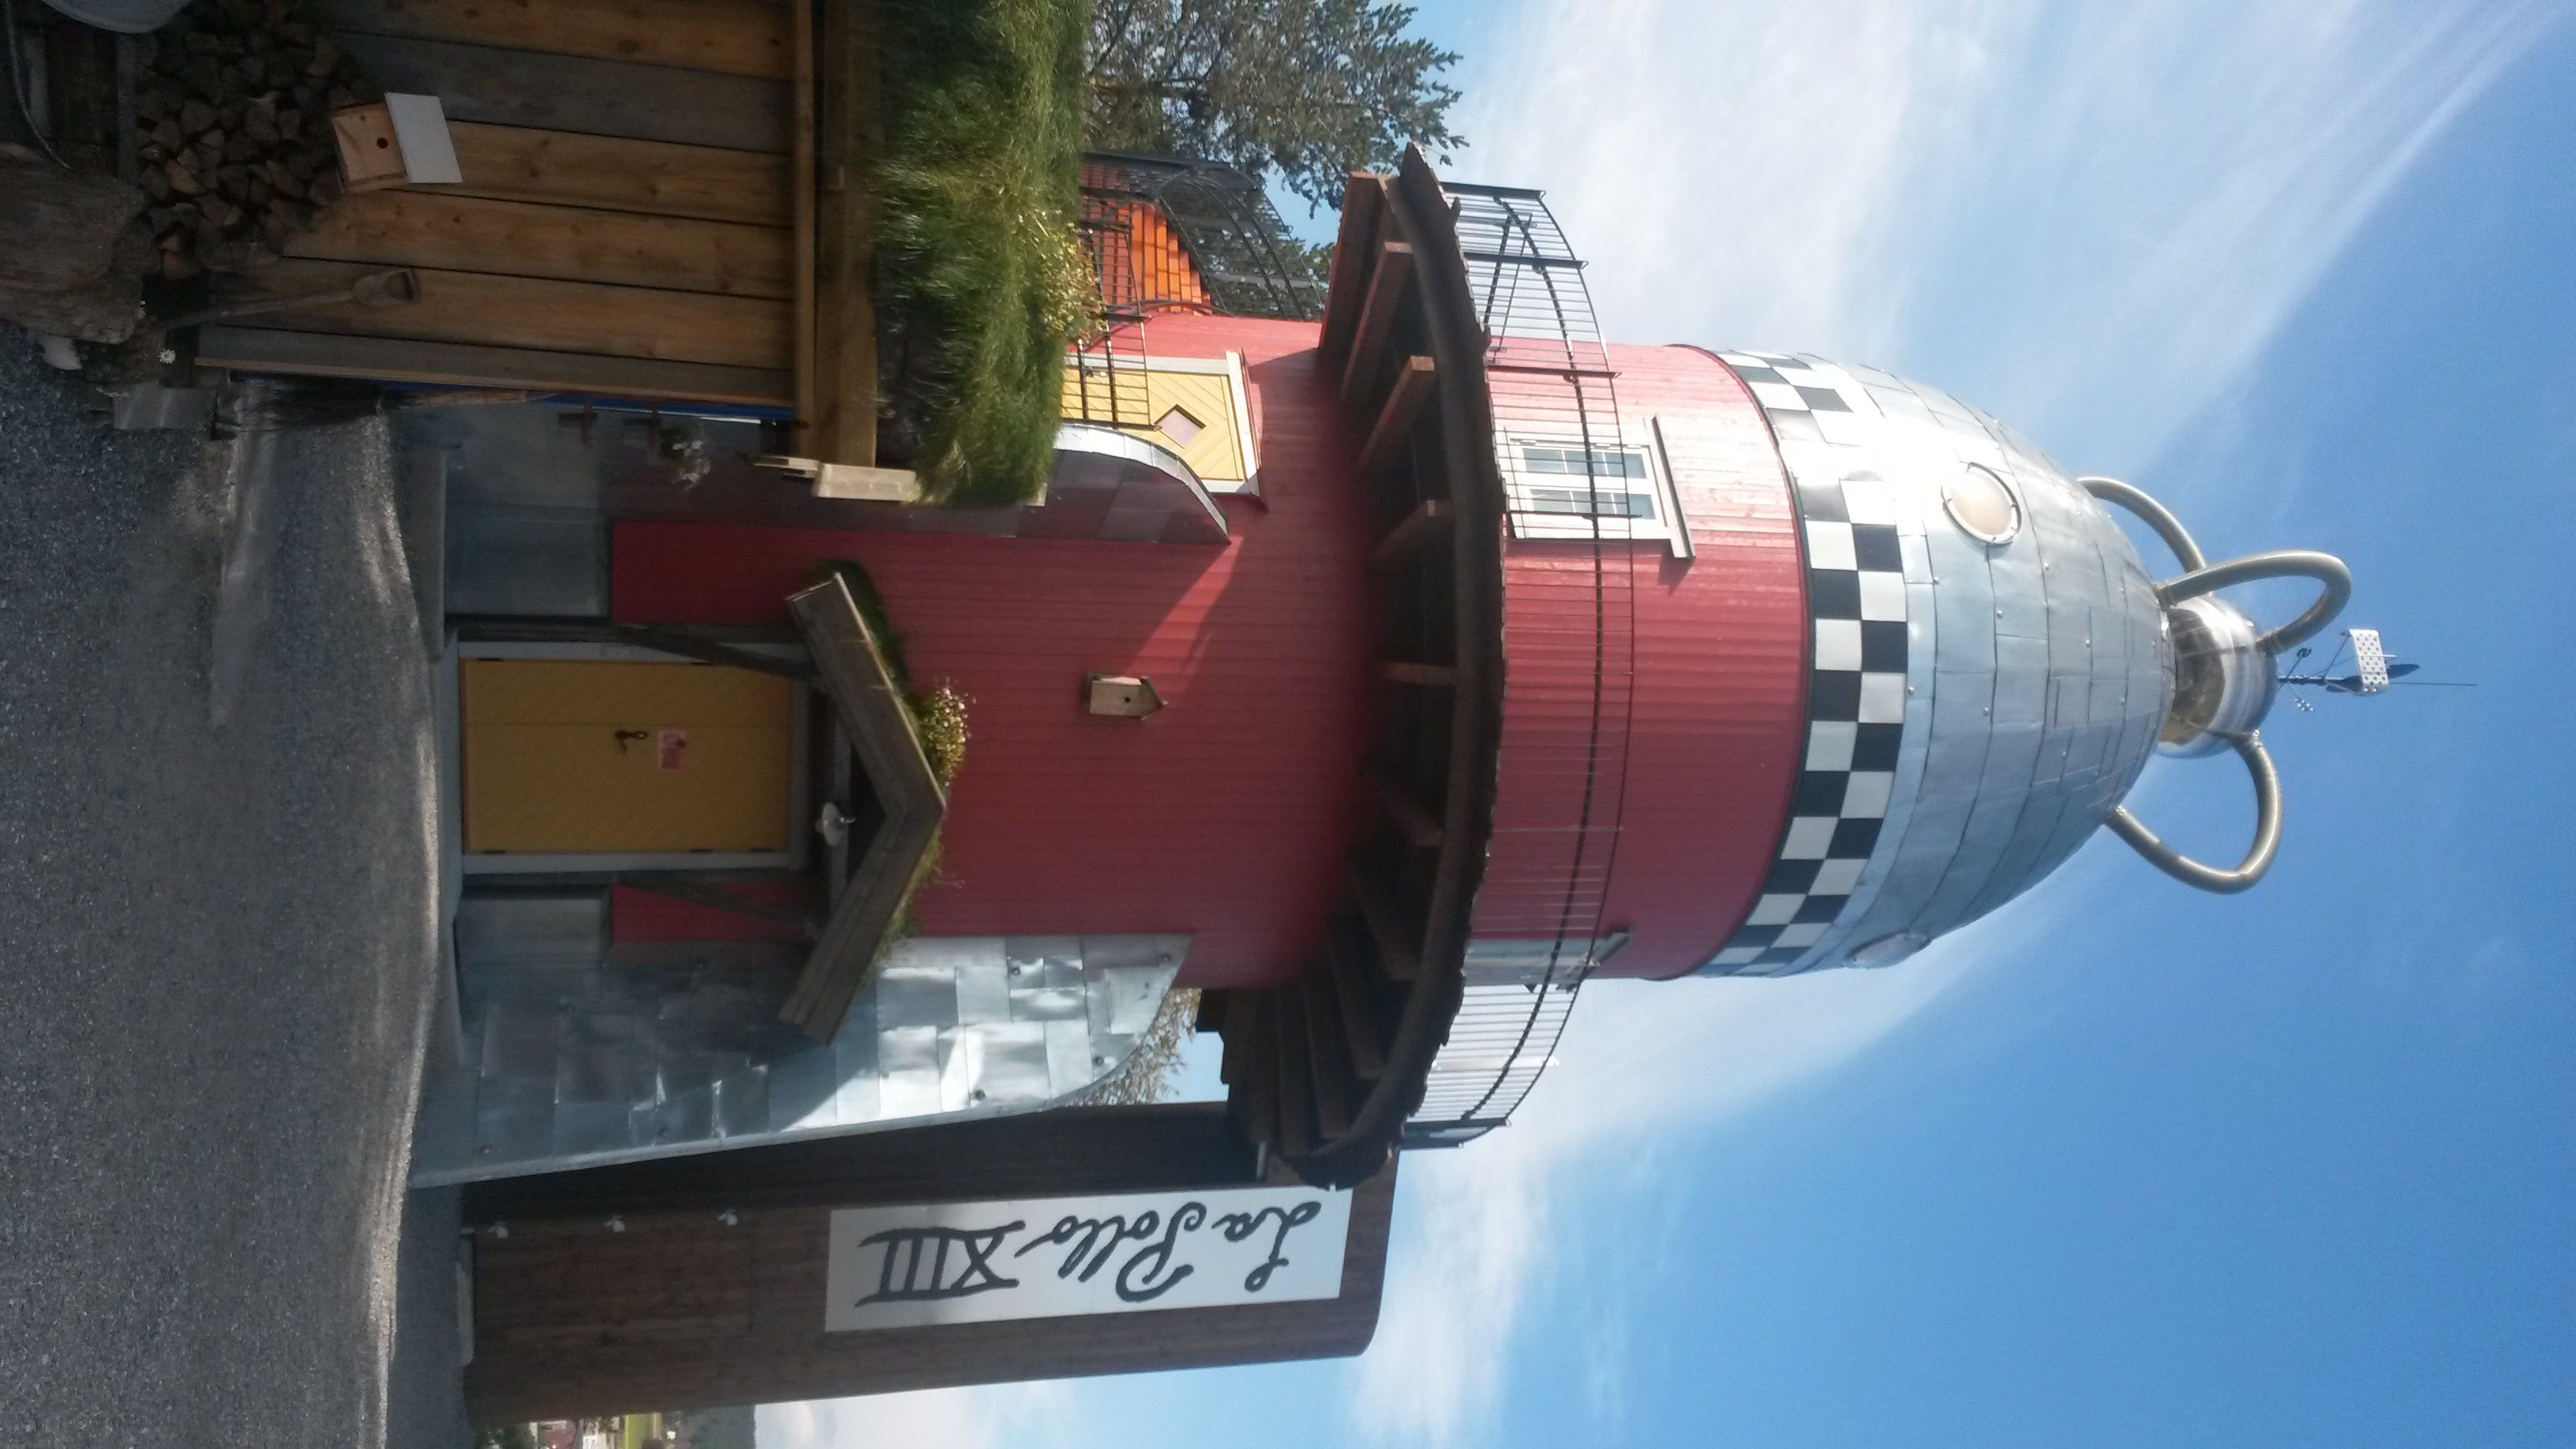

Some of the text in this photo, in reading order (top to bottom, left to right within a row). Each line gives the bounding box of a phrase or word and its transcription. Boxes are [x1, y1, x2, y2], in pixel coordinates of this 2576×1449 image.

[855, 1201, 1322, 1307] La Pollo XIII
